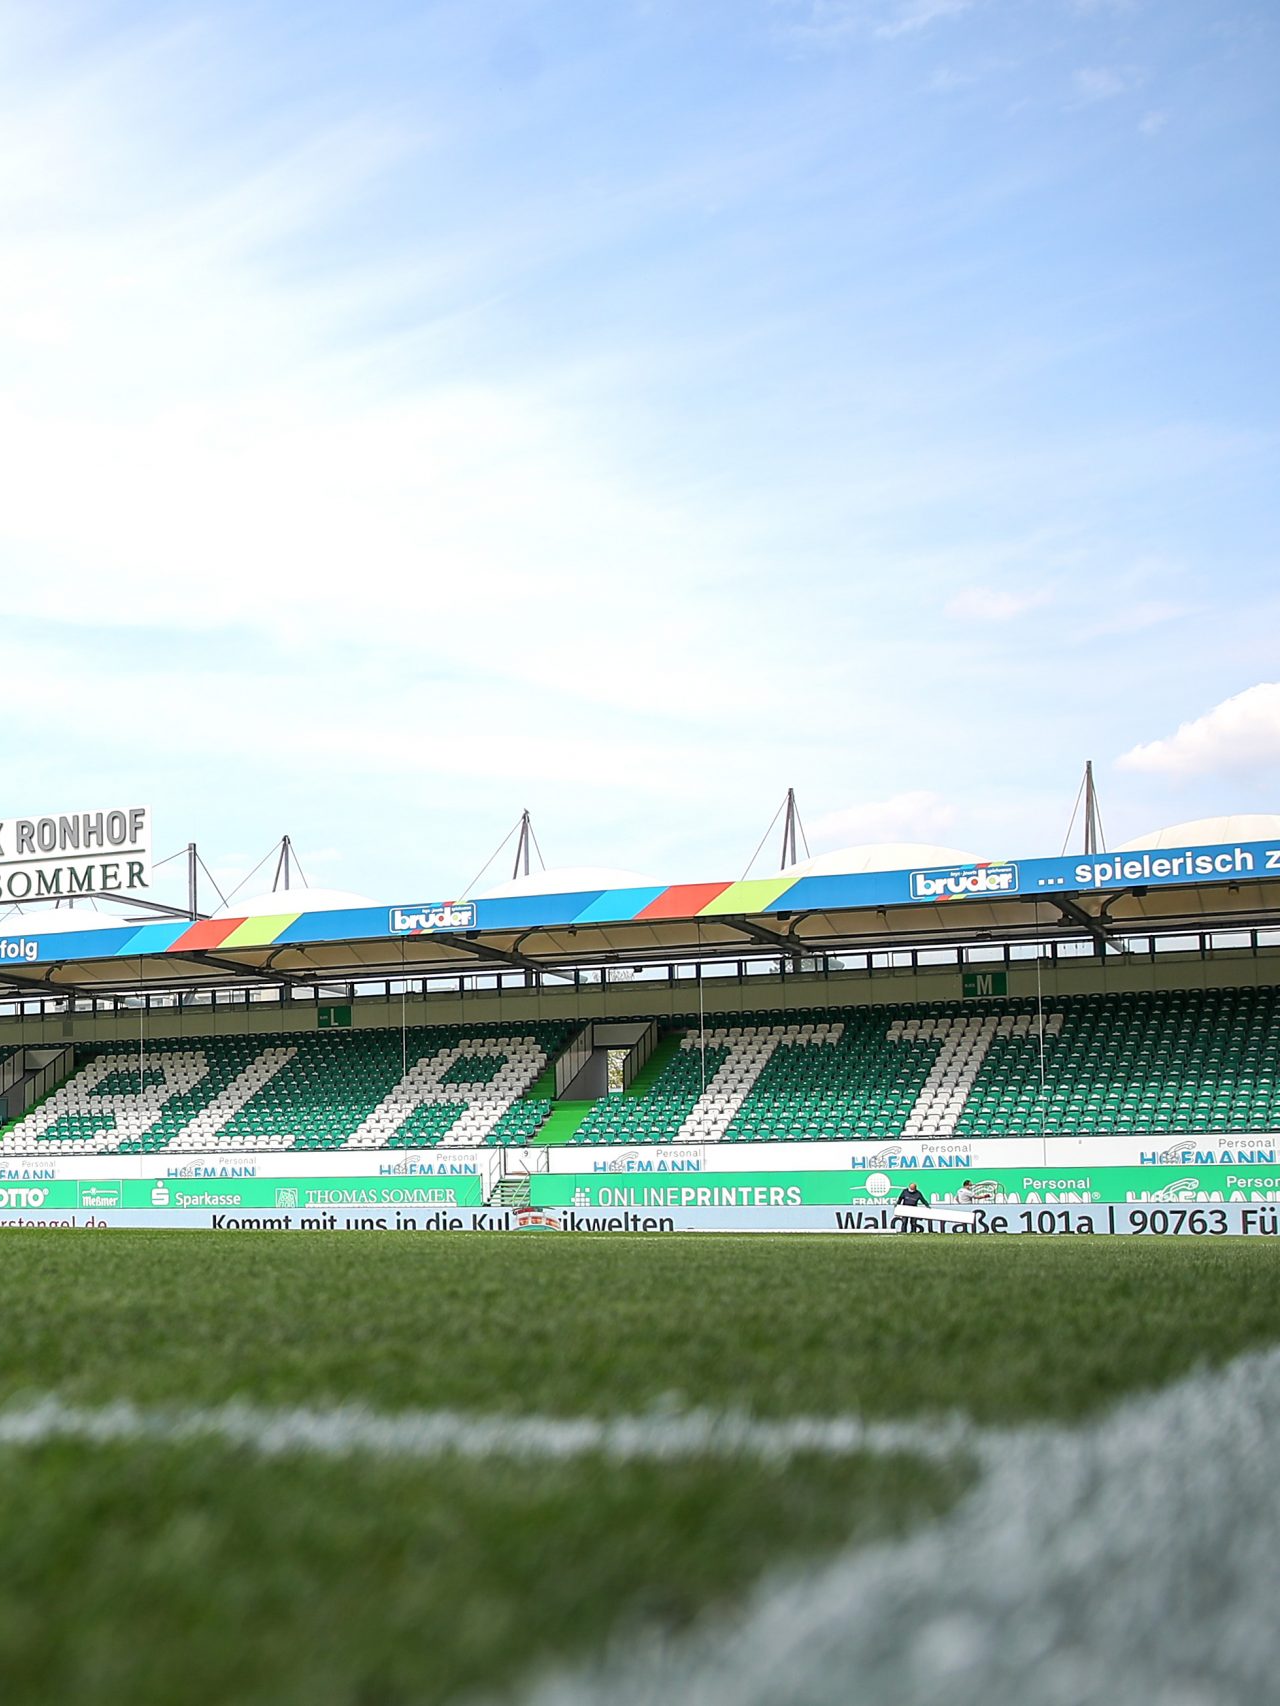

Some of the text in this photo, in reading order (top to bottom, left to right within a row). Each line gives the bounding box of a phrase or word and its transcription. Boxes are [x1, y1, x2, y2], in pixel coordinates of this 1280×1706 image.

[16, 808, 147, 854] RONHOF
[1075, 847, 1253, 887] spielerisch
[976, 974, 992, 995] M
[330, 1008, 339, 1026] L
[921, 1144, 972, 1153] Personal
[1218, 1138, 1276, 1148] Personal
[436, 1153, 478, 1162] Personal
[656, 1149, 702, 1158] Personal
[1140, 1150, 1275, 1164] HOFMANN
[21, 1160, 56, 1168] Personal
[593, 1160, 702, 1172] HOFMANN
[851, 1155, 973, 1169] HOFMANN
[166, 1166, 256, 1177] HOFMANN
[379, 1164, 478, 1175] HOFMANN
[1023, 1177, 1090, 1189] Personal
[175, 1192, 241, 1208] Sparkasse
[305, 1188, 457, 1203] THOMAS SOMMER
[598, 1186, 802, 1207] ONLINEPRINTERS
[212, 1213, 291, 1230] Kommt
[300, 1211, 338, 1230] mit
[346, 1219, 388, 1230] uns
[396, 1211, 417, 1230] in
[426, 1210, 463, 1230] die
[1020, 1210, 1094, 1234] 101a
[1129, 1209, 1228, 1234] 90763
